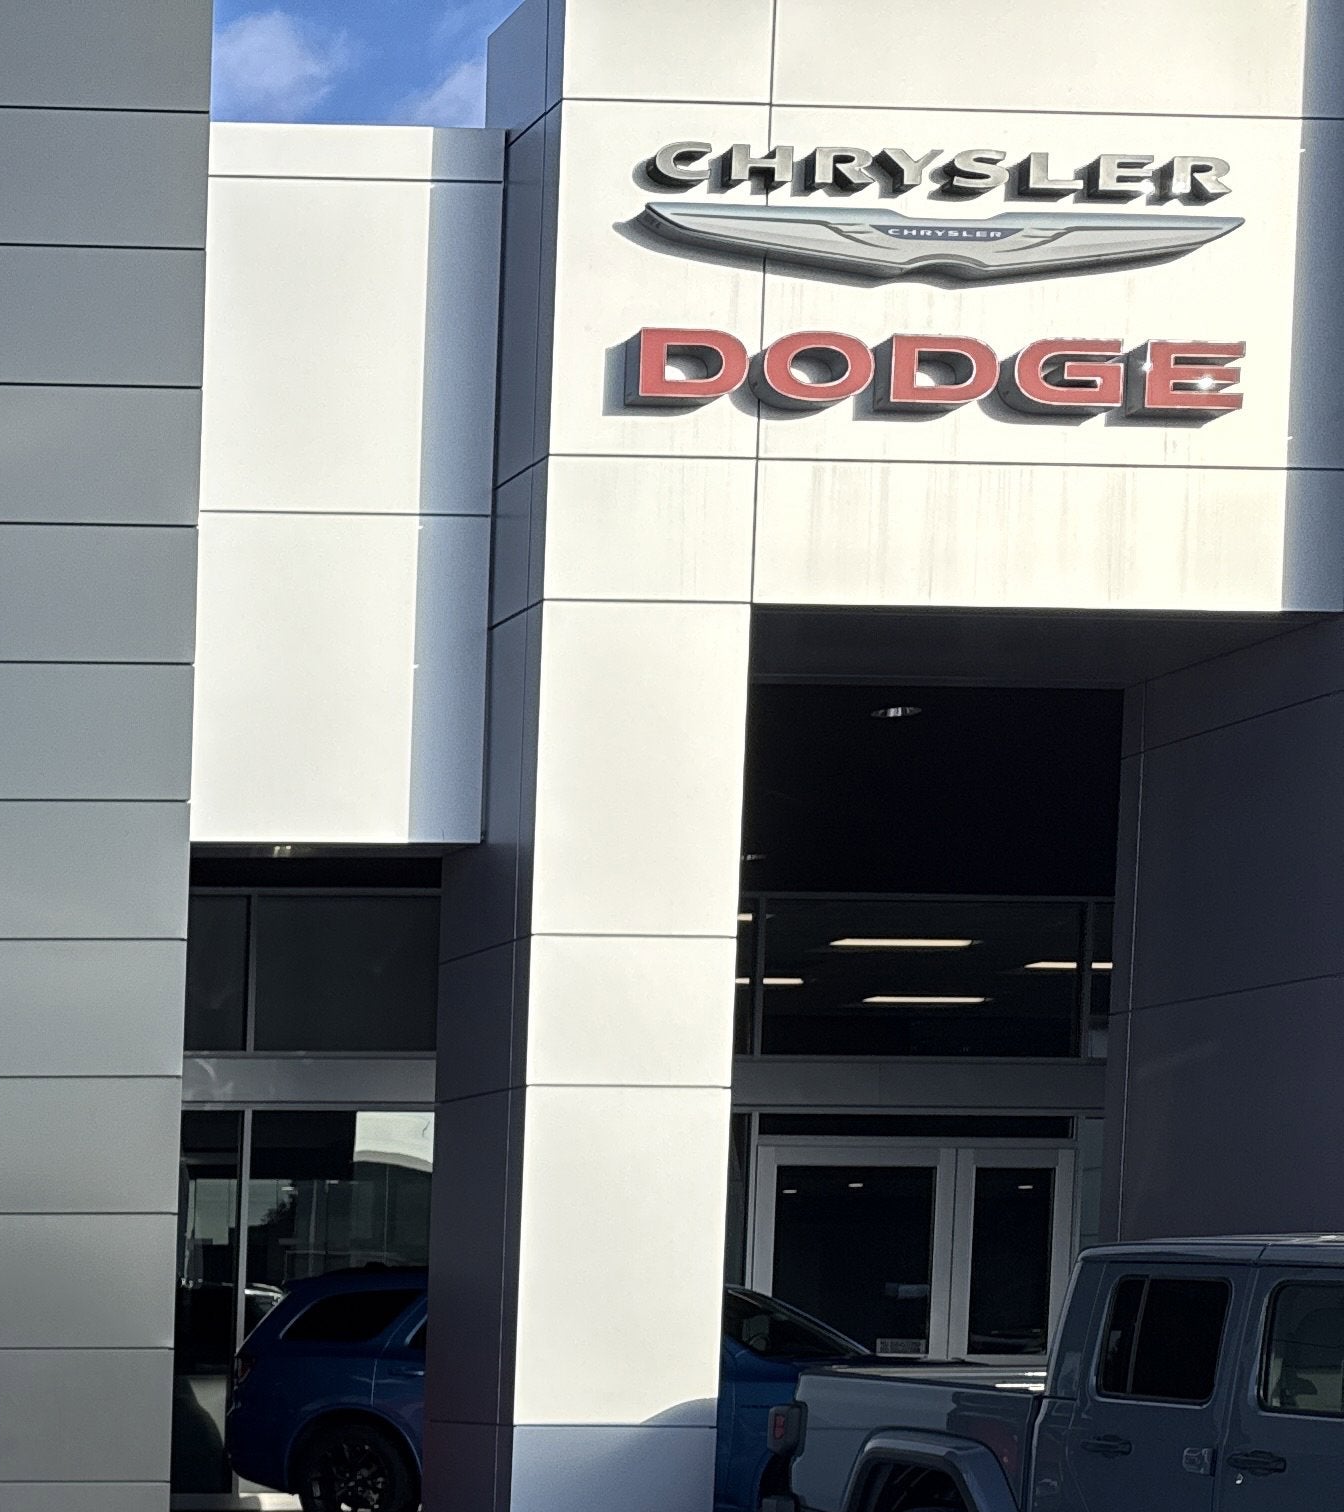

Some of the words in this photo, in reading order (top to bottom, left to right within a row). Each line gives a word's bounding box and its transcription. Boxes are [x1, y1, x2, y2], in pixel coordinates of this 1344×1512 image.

[652, 140, 1234, 197] CHRYSLER
[887, 228, 1003, 239] CHRYSLER
[638, 326, 1247, 411] DODGE
